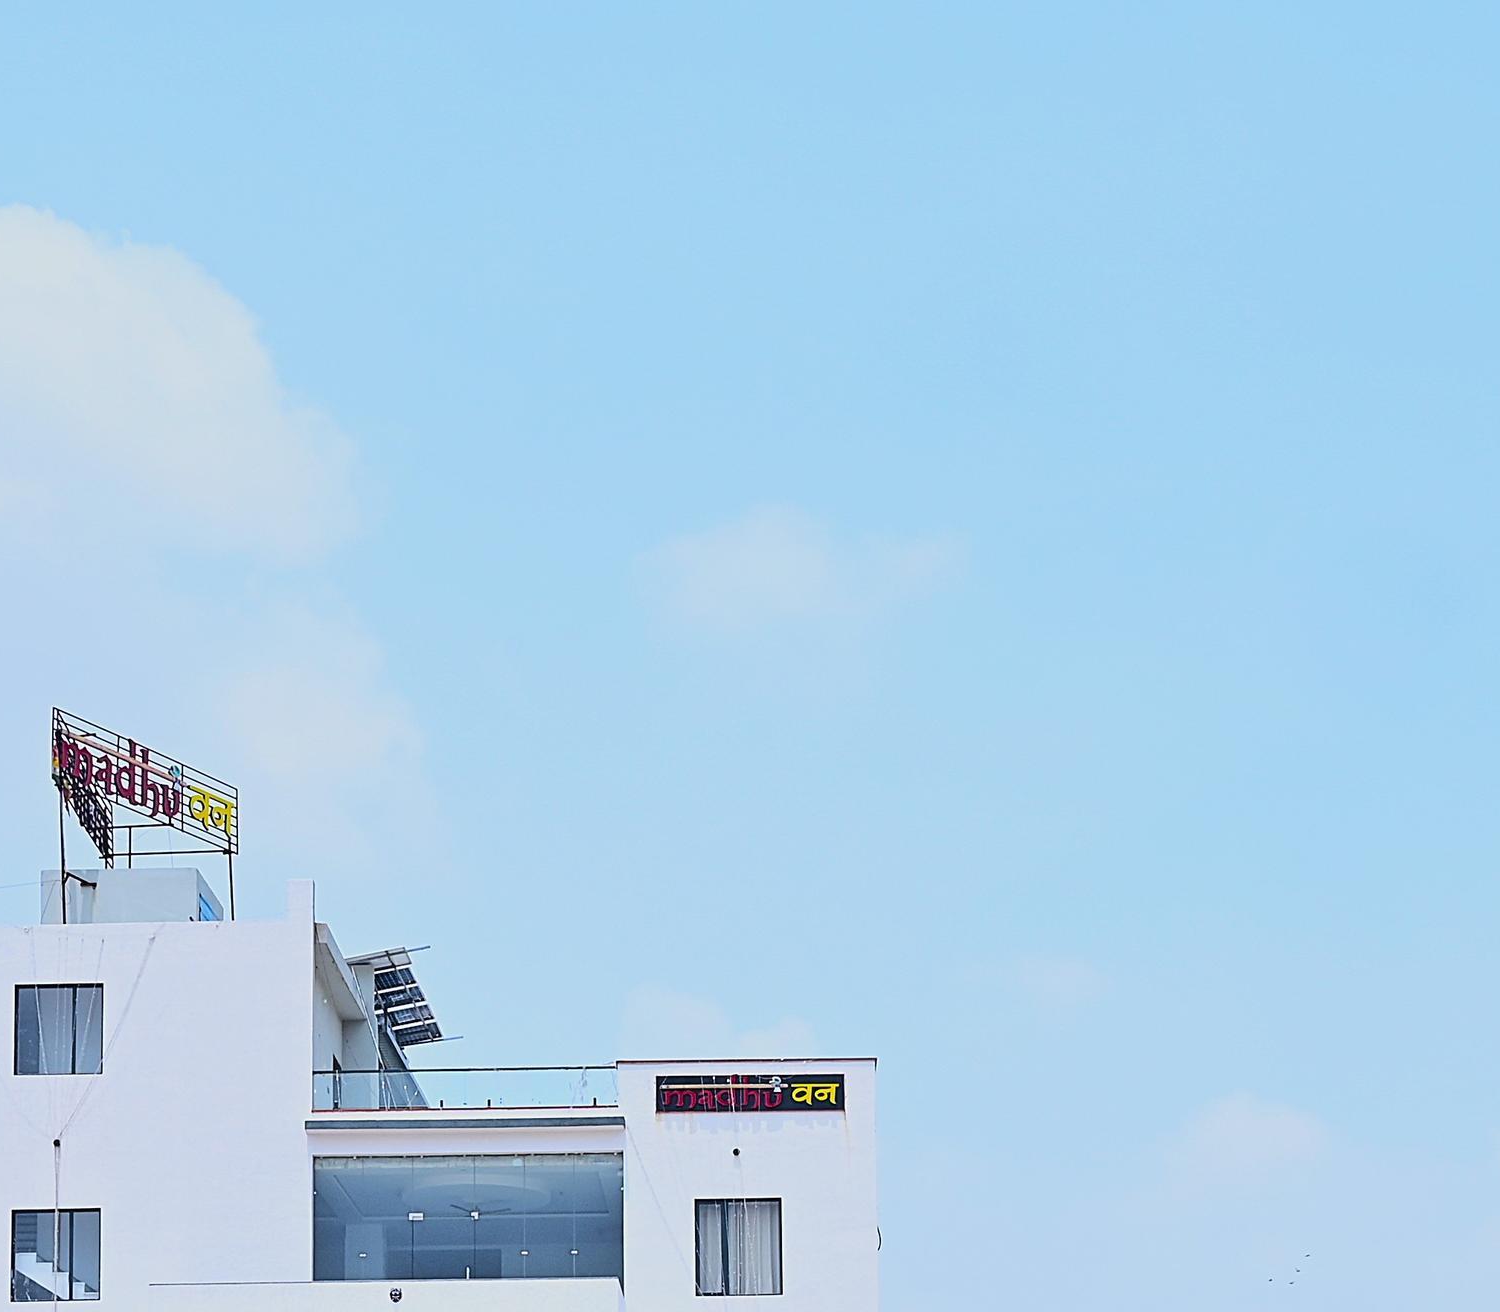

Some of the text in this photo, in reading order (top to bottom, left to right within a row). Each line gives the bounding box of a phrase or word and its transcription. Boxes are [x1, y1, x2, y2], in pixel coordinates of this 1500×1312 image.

[59, 738, 181, 818] madhu
[187, 784, 235, 838] वन
[663, 1075, 783, 1110] madhu
[791, 1083, 840, 1106] वन
